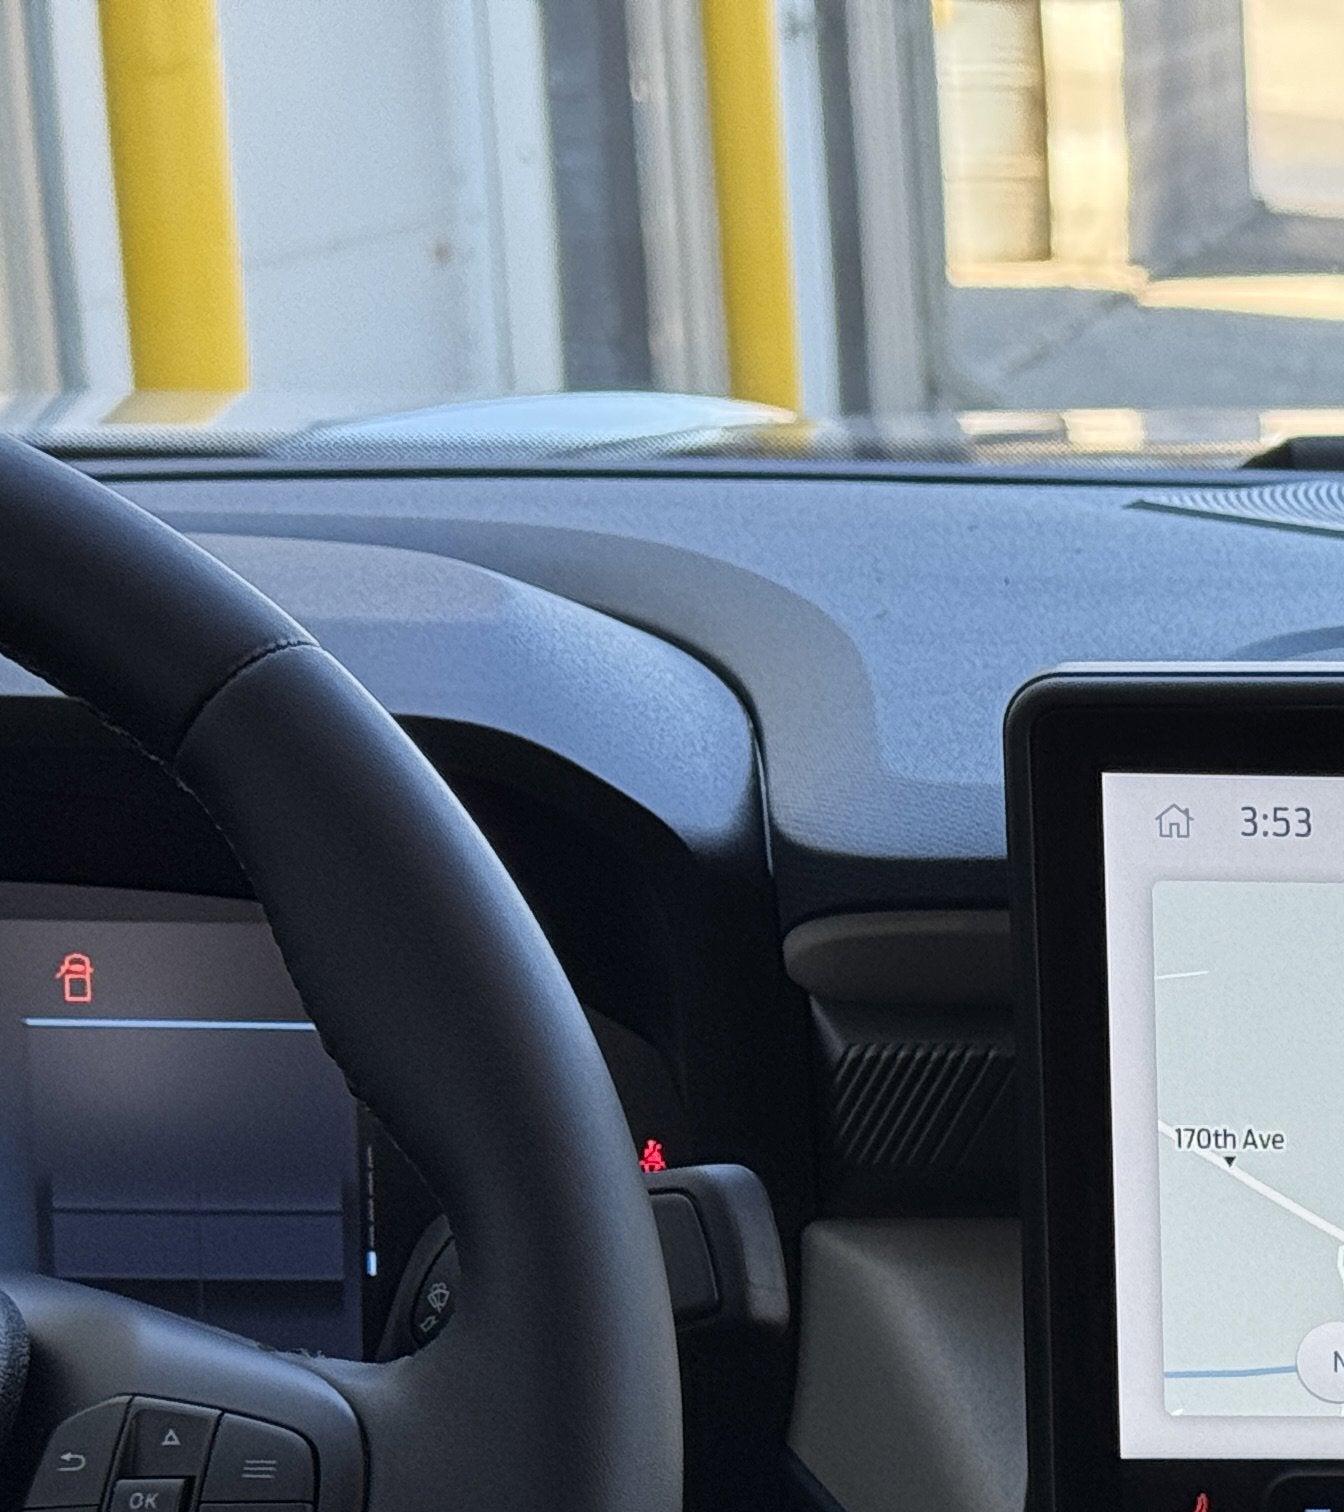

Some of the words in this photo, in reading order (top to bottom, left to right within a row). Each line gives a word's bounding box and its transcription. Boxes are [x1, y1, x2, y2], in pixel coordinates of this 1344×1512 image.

[1241, 806, 1312, 838] 3:53
[1175, 1127, 1236, 1150] 170th
[1242, 1128, 1285, 1150] Ave
[130, 1492, 159, 1510] OK
